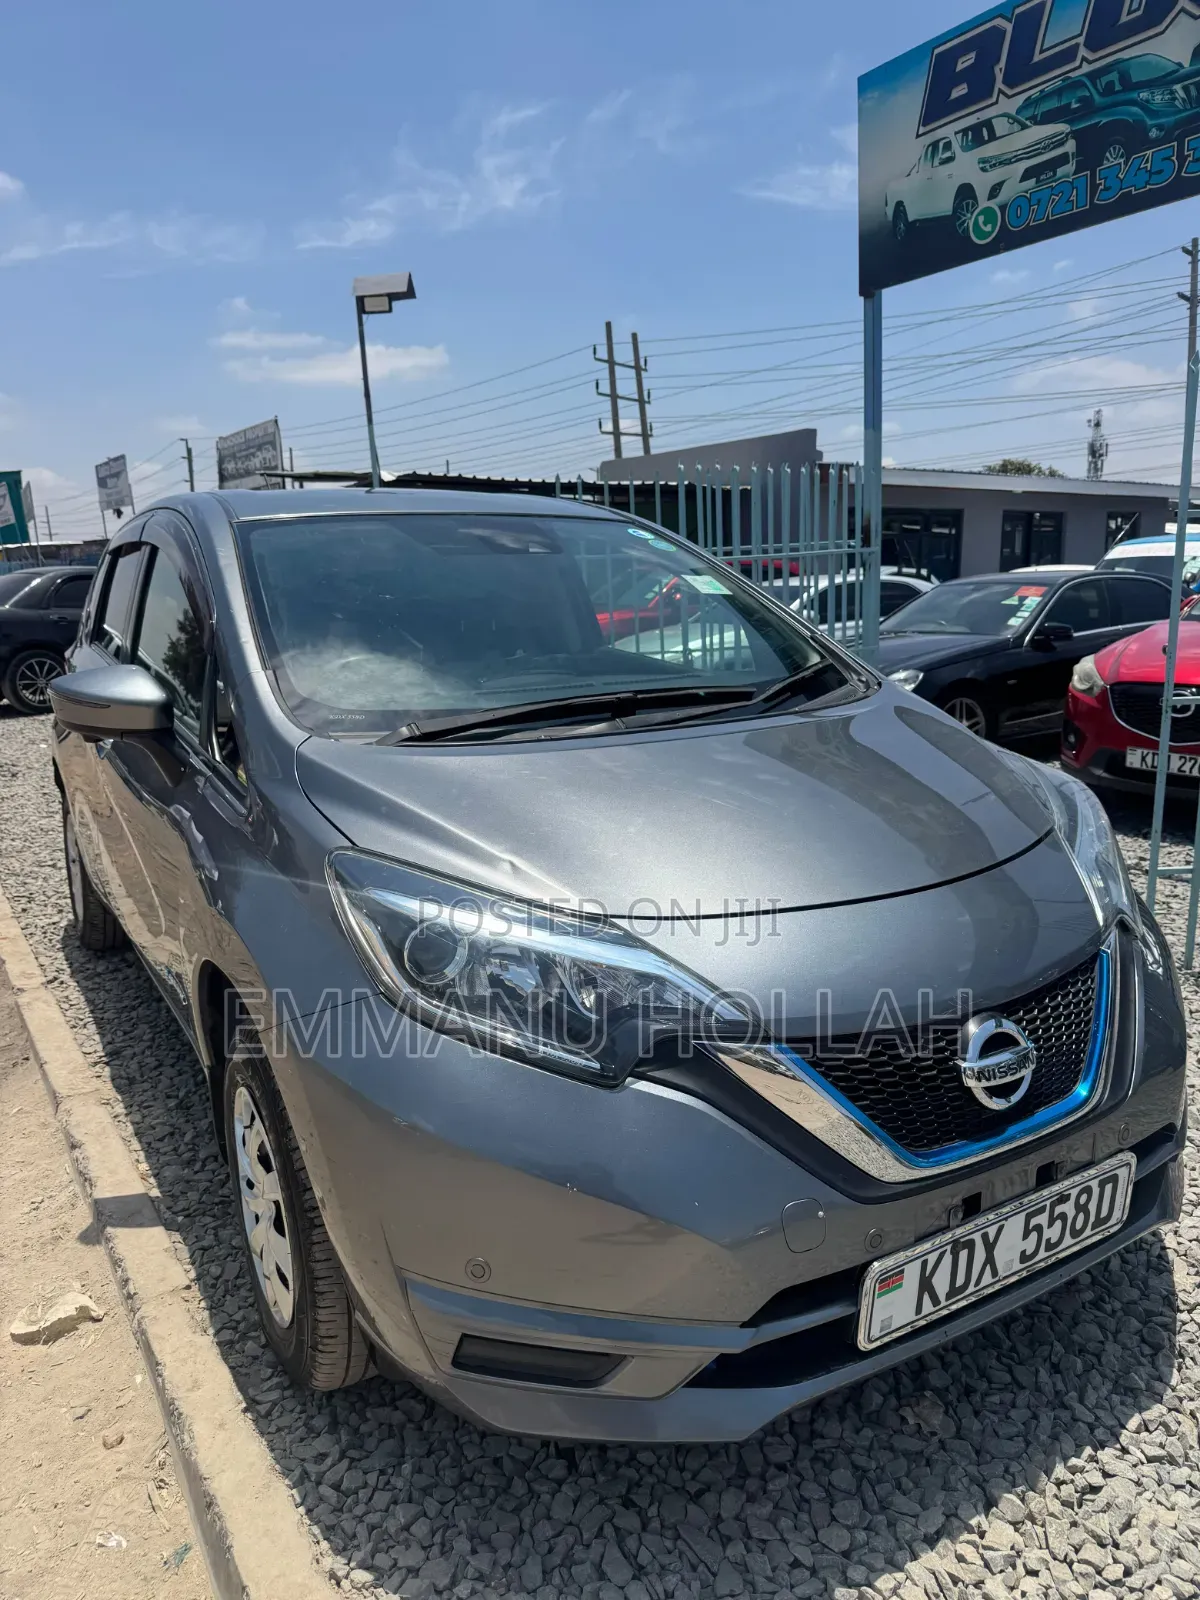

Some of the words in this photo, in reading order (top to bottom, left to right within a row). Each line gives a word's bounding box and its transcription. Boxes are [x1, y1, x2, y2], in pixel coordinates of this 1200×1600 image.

[1006, 172, 1090, 230] 0721
[1095, 142, 1178, 203] 345
[1140, 750, 1171, 772] KD
[1177, 755, 1200, 777] 27
[975, 1050, 1036, 1082] NISSAN
[914, 1221, 1005, 1317] KDX
[1018, 1172, 1120, 1265] 558D
